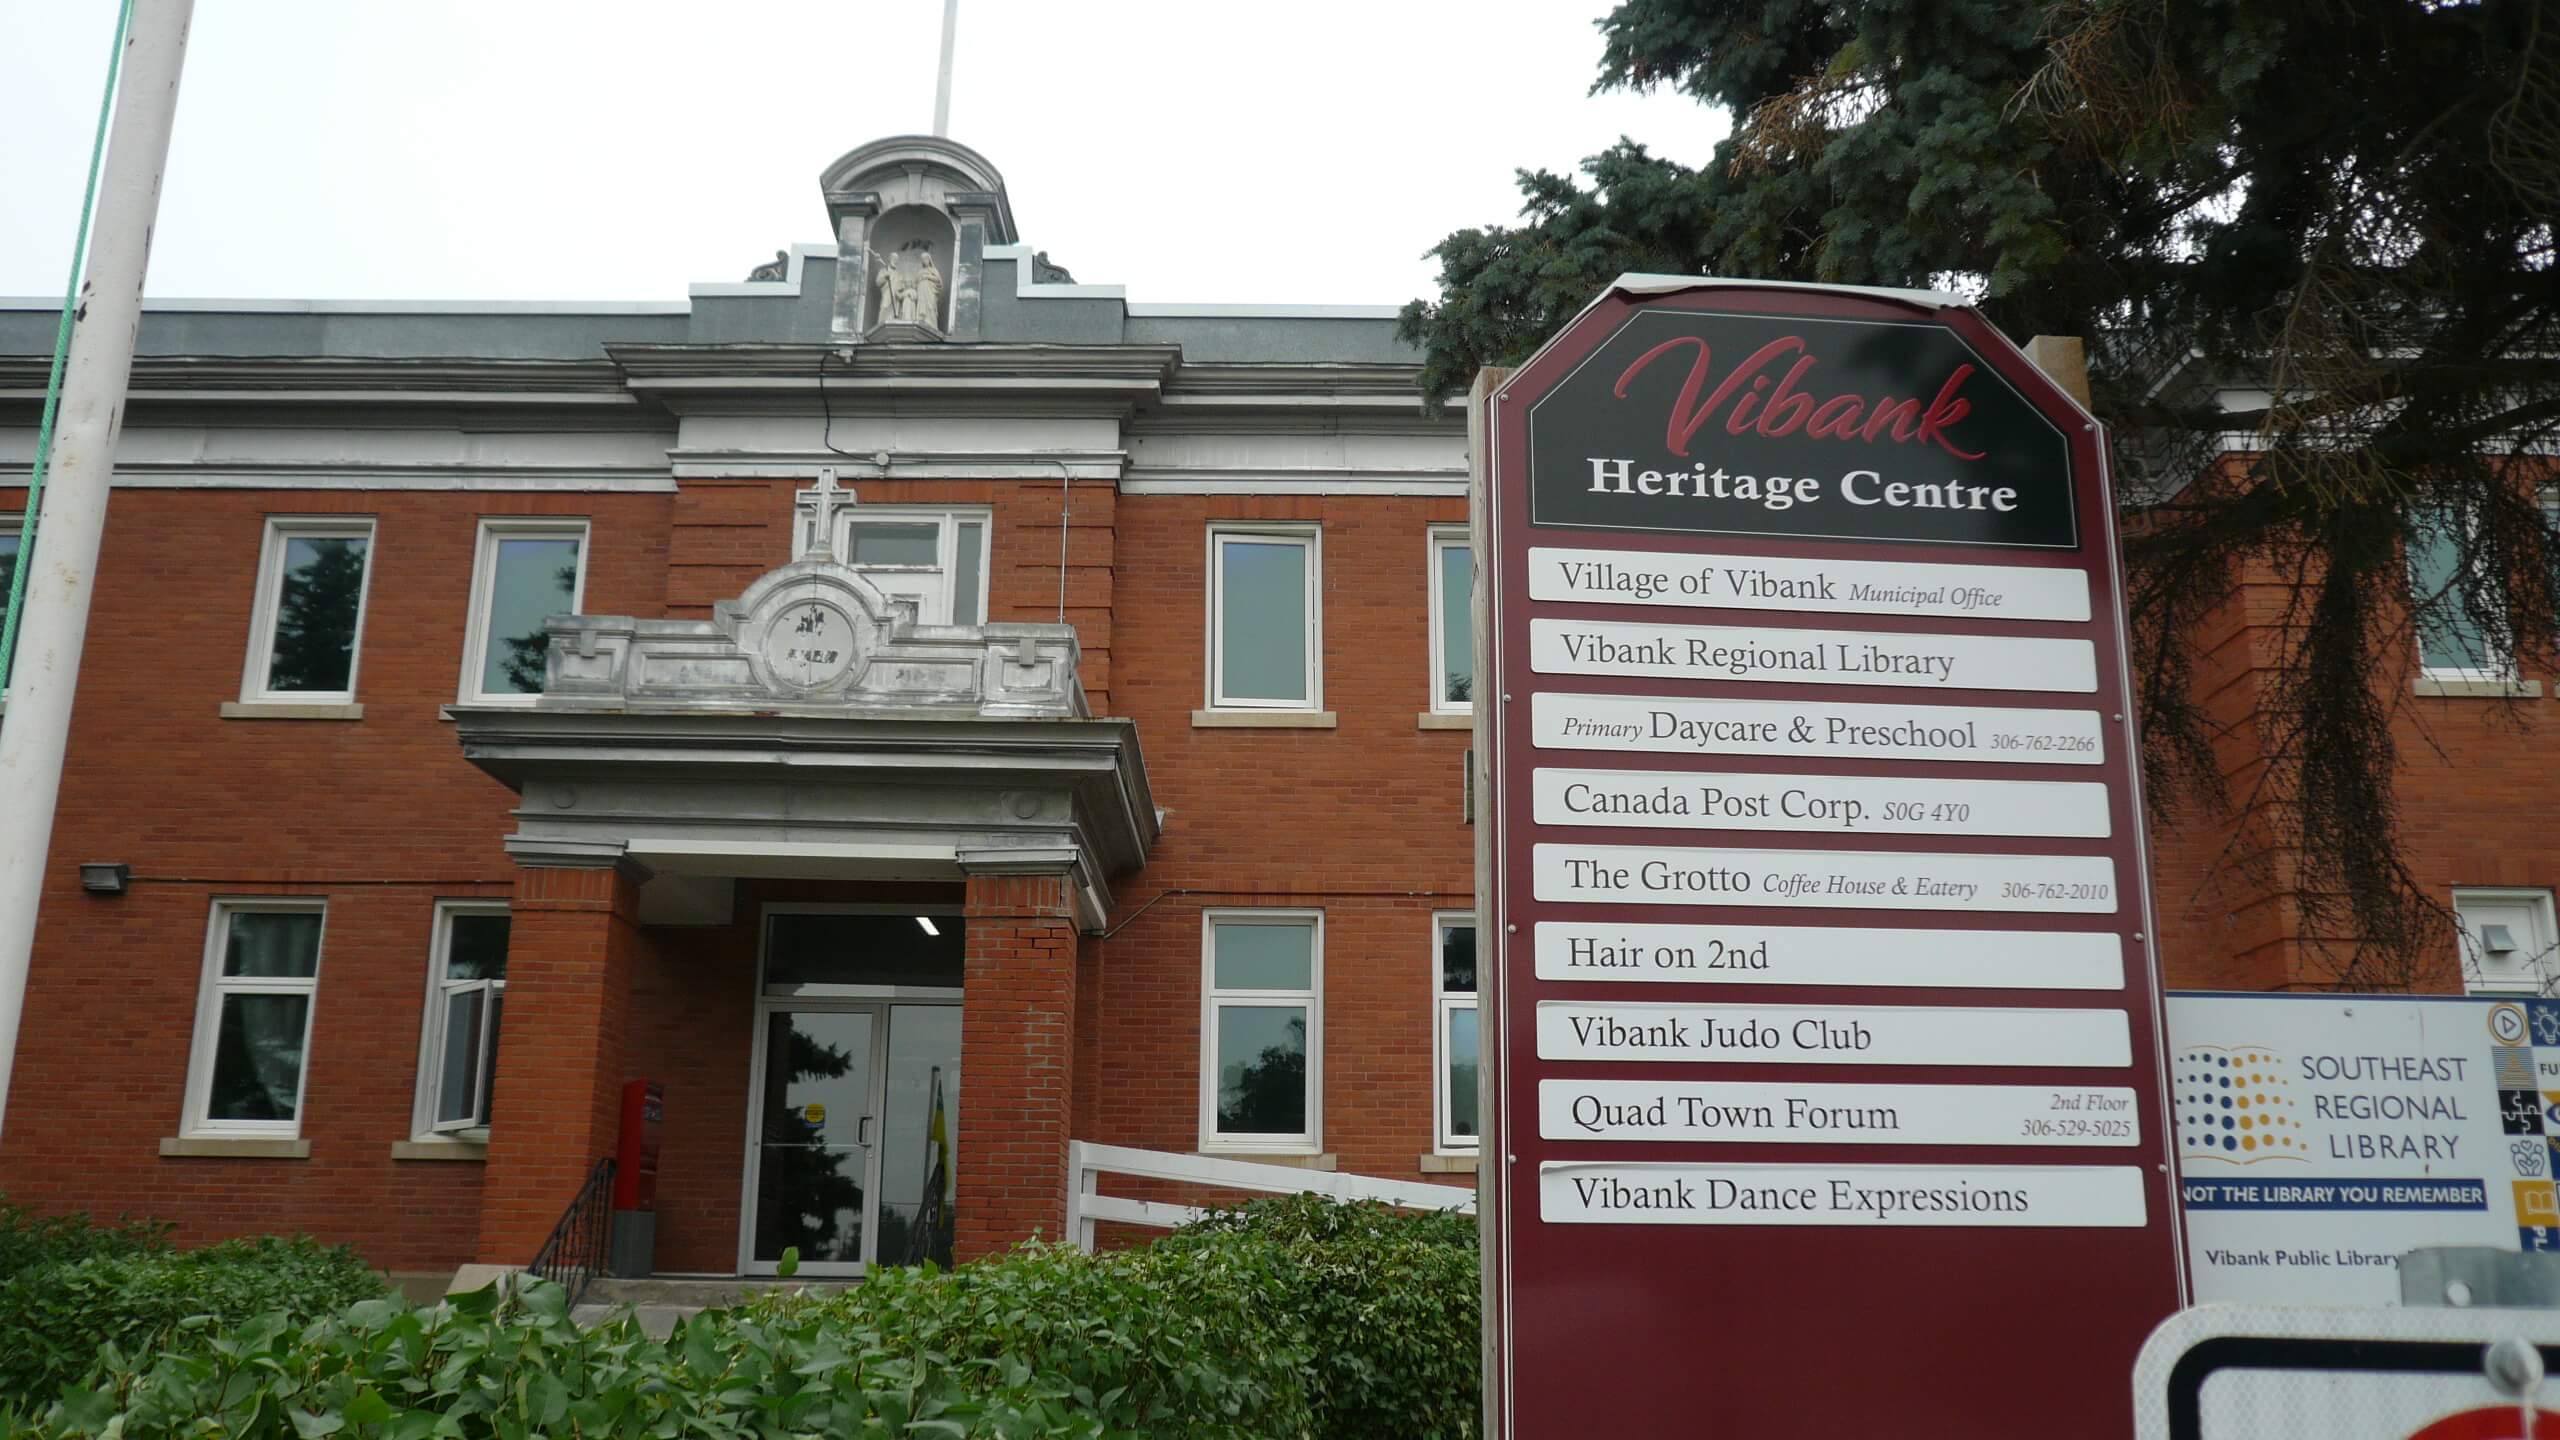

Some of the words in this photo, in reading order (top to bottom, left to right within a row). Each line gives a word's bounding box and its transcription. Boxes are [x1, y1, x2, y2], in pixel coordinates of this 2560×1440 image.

[1614, 335, 1987, 461] Vibank
[1587, 458, 1819, 509] Heritage
[1841, 471, 2017, 511] Centre
[1559, 562, 1668, 599] Village
[1680, 568, 1713, 594] of
[1724, 569, 1837, 599] Vibank
[1848, 584, 1944, 607] Municipal
[1951, 588, 2002, 609] Office
[1560, 634, 1676, 664] Vibank
[1686, 639, 1827, 674] Regional
[1836, 645, 1955, 681] Library
[1562, 718, 1642, 742] Primary
[1648, 712, 1777, 747] Daycare
[1788, 716, 1816, 743] &
[1824, 718, 1976, 748] Preschool
[1991, 734, 2095, 751] 306-762-2266
[1565, 784, 1690, 815] Canada
[1701, 788, 1769, 817] Post
[1781, 790, 1869, 827] Corp.
[1565, 860, 1629, 889] The
[1642, 861, 1750, 892] Grotto
[1764, 874, 1820, 897] Coffee
[1826, 875, 1885, 894] House
[1892, 877, 1908, 895] &
[1914, 877, 1977, 901] Eatery
[2002, 882, 2108, 900] 306-762-2010
[1568, 938, 1643, 967] Hair
[1655, 948, 1696, 968] on
[1708, 940, 1770, 969] 2nd
[1568, 1016, 1690, 1047] Vibank
[1701, 1019, 1779, 1048] Judo
[1793, 1020, 1871, 1050] Club
[2302, 1056, 2467, 1081] SOUTHEAST
[2540, 1063, 2560, 1076] FU
[1573, 1096, 1666, 1132] Quad
[1678, 1097, 1774, 1127] Town
[1784, 1099, 1899, 1129] Forum
[2050, 1094, 2082, 1110] 2nd
[2086, 1095, 2129, 1111] Floor
[2315, 1095, 2467, 1120] REGIONAL
[2021, 1120, 2131, 1137] 306-529-5025
[2330, 1134, 2459, 1159] LIBRARY
[1572, 1178, 1695, 1208] Vibank
[1707, 1179, 1816, 1210] Dance
[1828, 1180, 2028, 1217] Expressions
[2222, 1187, 2259, 1201] THE
[2264, 1187, 2334, 1202] LIBRARY
[2340, 1187, 2377, 1202] YOU
[2383, 1187, 2482, 1203] REMEMBER
[2205, 1250, 2270, 1265] Vibank
[2275, 1250, 2330, 1265] Public
